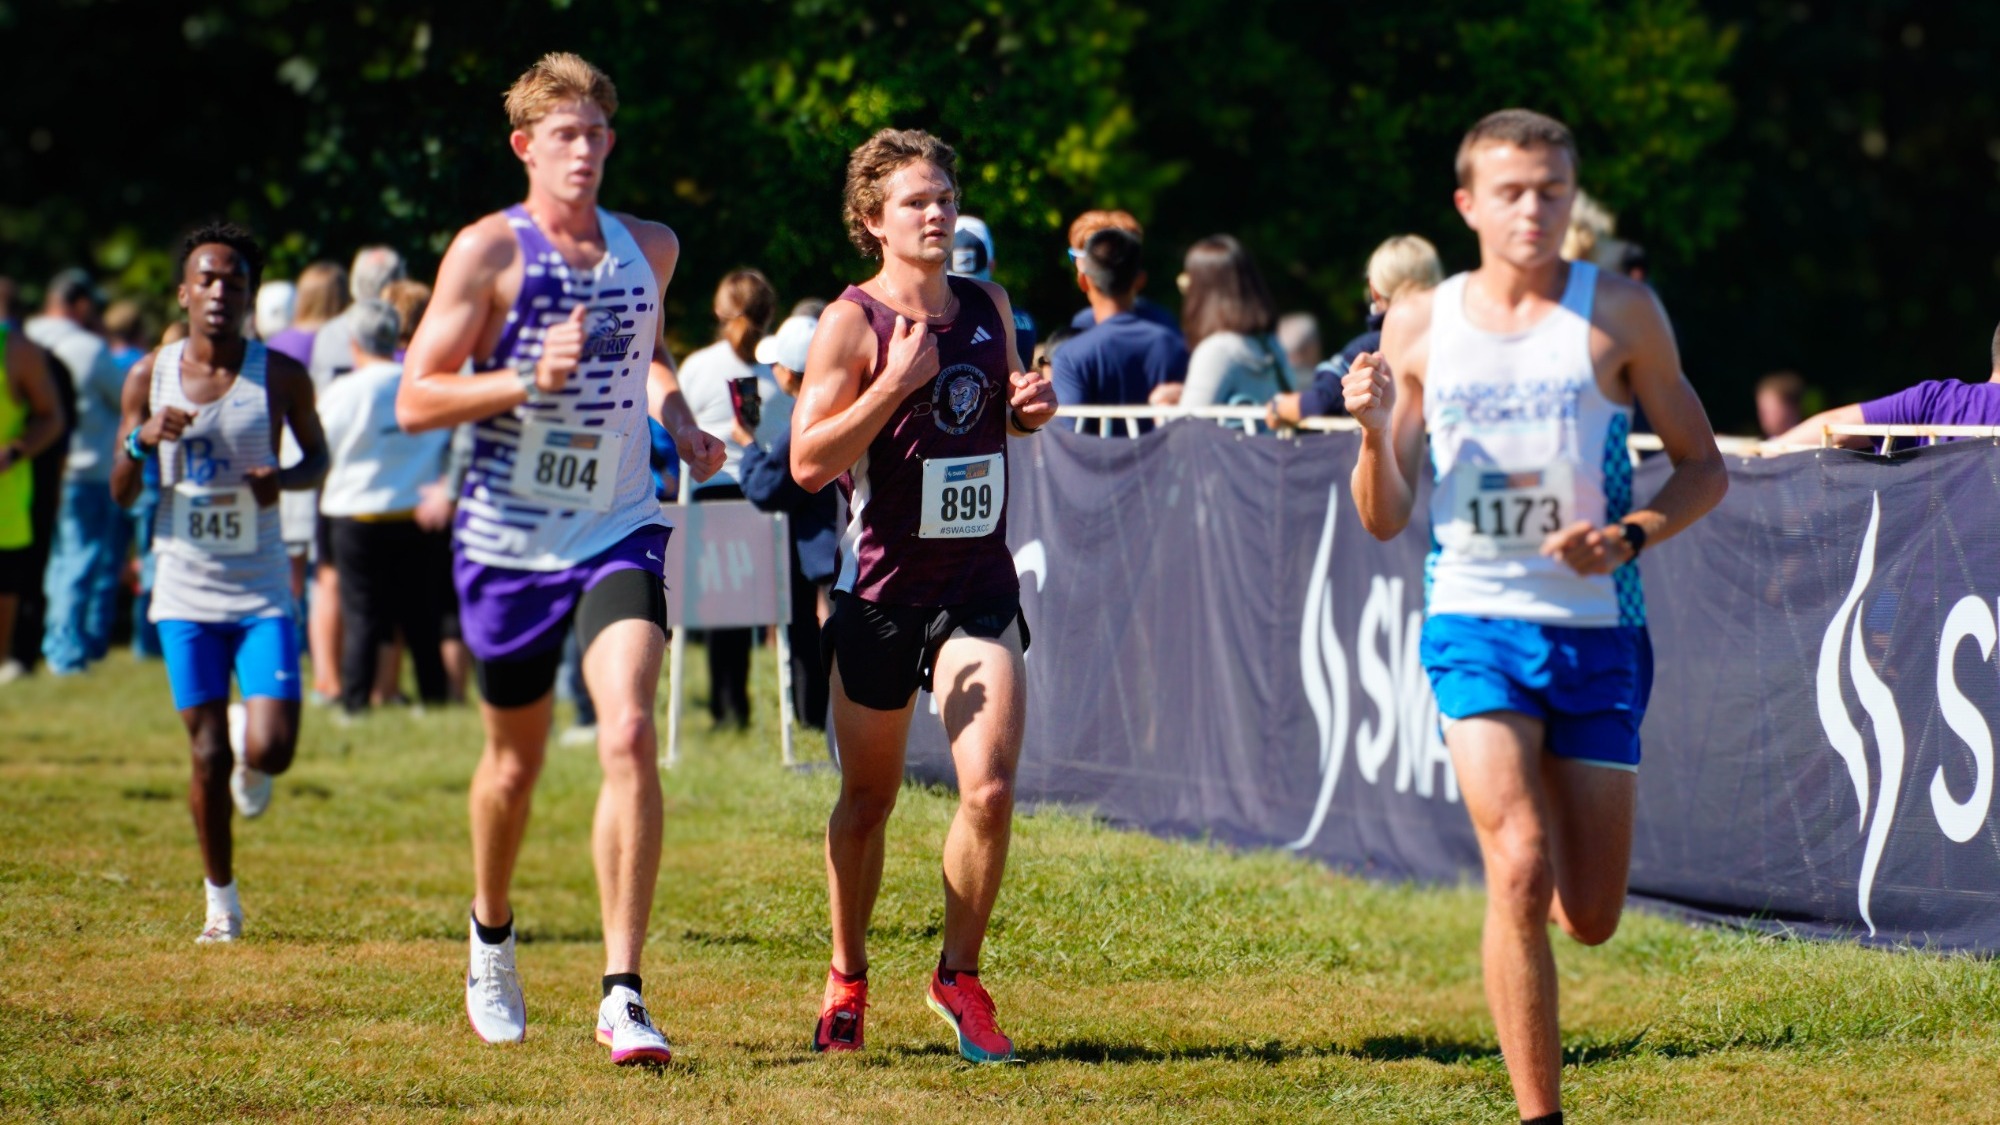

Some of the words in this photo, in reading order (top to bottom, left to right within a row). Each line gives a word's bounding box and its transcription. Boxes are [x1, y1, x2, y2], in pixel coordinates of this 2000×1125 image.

[535, 450, 599, 492] 804
[940, 484, 992, 522] 899
[1467, 495, 1562, 537] 1173
[188, 511, 242, 540] 845
[1930, 595, 2000, 843] S
